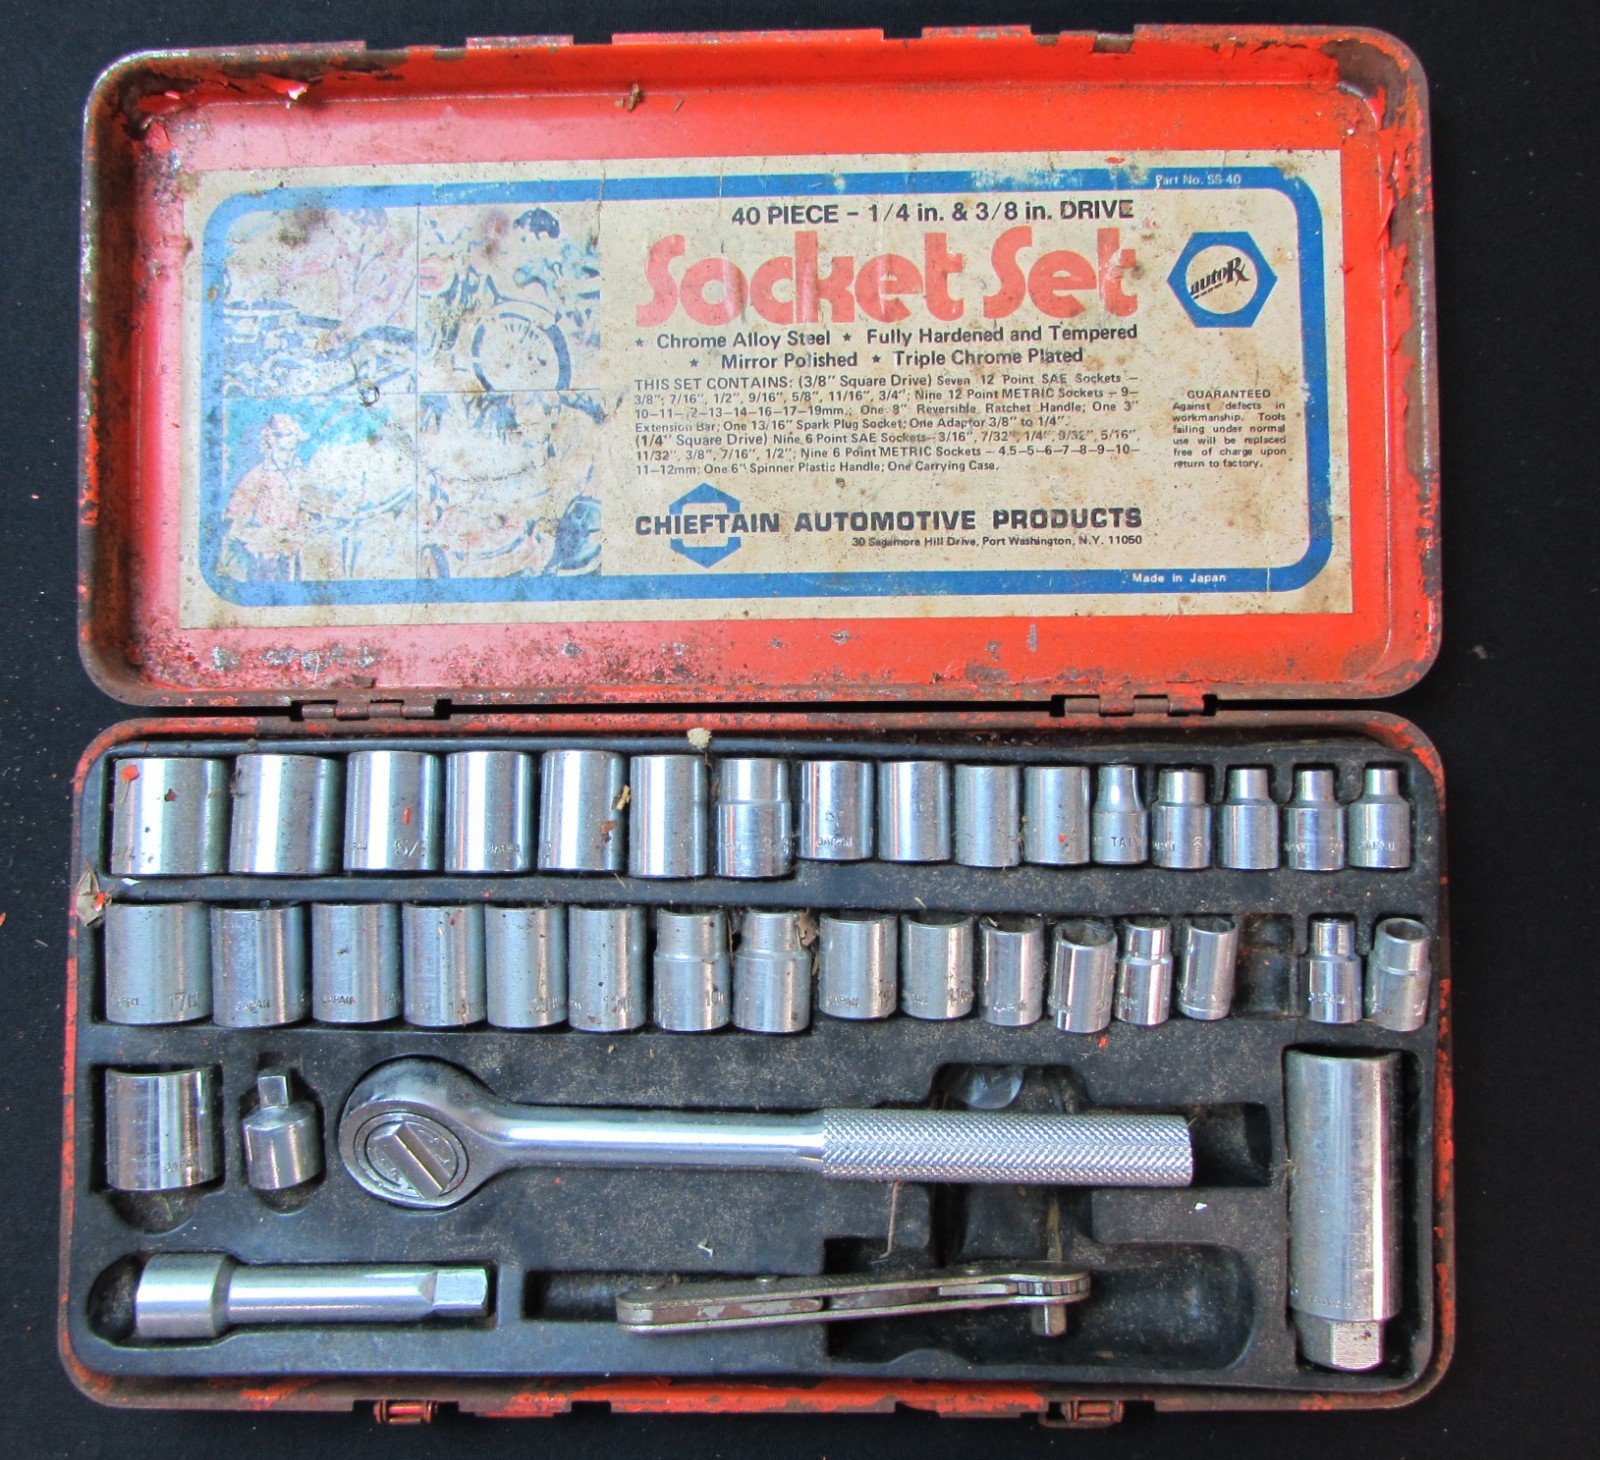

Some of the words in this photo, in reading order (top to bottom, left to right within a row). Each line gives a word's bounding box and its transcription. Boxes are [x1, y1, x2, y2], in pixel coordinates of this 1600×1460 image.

[1156, 174, 1178, 185] Part
[1183, 174, 1204, 185] No.
[731, 207, 761, 226] 40
[767, 205, 838, 225] PIECE
[868, 203, 910, 223] 1/4
[918, 203, 945, 223] in.
[951, 203, 968, 222] &
[975, 202, 1017, 222] 3/8
[1026, 202, 1052, 220] in.
[1060, 200, 1134, 220] DRIVE
[635, 229, 966, 327] Socket
[983, 226, 1138, 321] Set
[656, 333, 726, 349] Chrome
[732, 331, 781, 349] Alloy
[787, 330, 830, 345] Steel
[867, 328, 912, 346] Fully
[919, 326, 1003, 343] Hardened
[1010, 326, 1042, 342] and
[1049, 324, 1137, 342] Tempered
[721, 353, 777, 369] Mirror
[784, 352, 857, 368] Polished
[895, 350, 945, 368] Triple
[951, 348, 1021, 365] Chrome
[1028, 348, 1083, 363] Plated
[635, 379, 669, 390] THIS
[674, 378, 702, 390] SET
[840, 375, 886, 389] Square
[891, 374, 932, 387] Drive)
[937, 375, 971, 386] Seven
[981, 375, 994, 385] 12
[1003, 374, 1034, 385] Point
[1041, 373, 1067, 384] SAE
[1075, 373, 1121, 383] Sockets
[915, 390, 942, 400] Nine
[949, 389, 962, 399] 12
[967, 389, 998, 399] Point
[1002, 388, 1054, 398] METRIC
[1058, 387, 1104, 398] Sockets
[1187, 389, 1271, 399] GUARANTEED
[861, 405, 884, 415] One
[917, 403, 977, 414] Reversible
[985, 403, 1031, 413] Ratchet
[1092, 401, 1117, 411] One
[1172, 402, 1210, 412] Against
[1226, 401, 1262, 410] defects
[1275, 401, 1285, 410] in
[1172, 412, 1244, 422] workmanship.
[1258, 412, 1286, 421] Tools
[635, 422, 692, 432] Extension
[723, 421, 747, 431] One
[796, 419, 830, 431] Spark
[834, 419, 859, 431] Plug
[909, 418, 933, 428] One
[937, 418, 985, 429] Adaptor
[1021, 418, 1033, 427] to
[1173, 425, 1205, 435] failing
[1213, 425, 1242, 433] under
[1250, 424, 1285, 433] normal
[676, 434, 722, 448] Square
[727, 433, 768, 446] Drive)
[773, 434, 800, 444] Nine
[805, 434, 813, 444] 6
[816, 433, 848, 444] Point
[851, 433, 877, 443] SAE
[1198, 436, 1216, 445] will
[1224, 436, 1236, 445] be
[1244, 436, 1286, 445] replaced
[800, 448, 828, 458] Nine
[833, 447, 841, 457] 6
[845, 447, 876, 457] Point
[880, 446, 932, 457] METRIC
[936, 446, 981, 457] Sockets
[1173, 448, 1192, 457] free
[1201, 448, 1213, 456] of
[1219, 448, 1253, 457] charge
[1260, 449, 1286, 457] upon
[704, 464, 728, 474] One
[750, 462, 794, 475] Spinner
[798, 462, 836, 473] Plastic
[888, 461, 911, 471] One
[915, 461, 965, 472] Carrying
[969, 460, 999, 471] Case.
[1174, 460, 1205, 468] return
[1209, 460, 1219, 468] to
[635, 512, 780, 535] CHIEFTAIN
[795, 510, 976, 532] AUTOMOTIVE
[993, 507, 1142, 530] PRODUCTS
[852, 537, 866, 547] 30
[868, 537, 920, 548] Sagamore
[924, 536, 944, 546] Hill
[947, 536, 979, 547] Drive,
[982, 536, 1006, 546] Port
[1008, 536, 1075, 547] Washington,
[1078, 535, 1104, 545] N.Y.
[1109, 535, 1142, 545] 11050
[1132, 573, 1165, 583] Made
[1172, 573, 1183, 583] in
[1190, 572, 1226, 584] Japan
